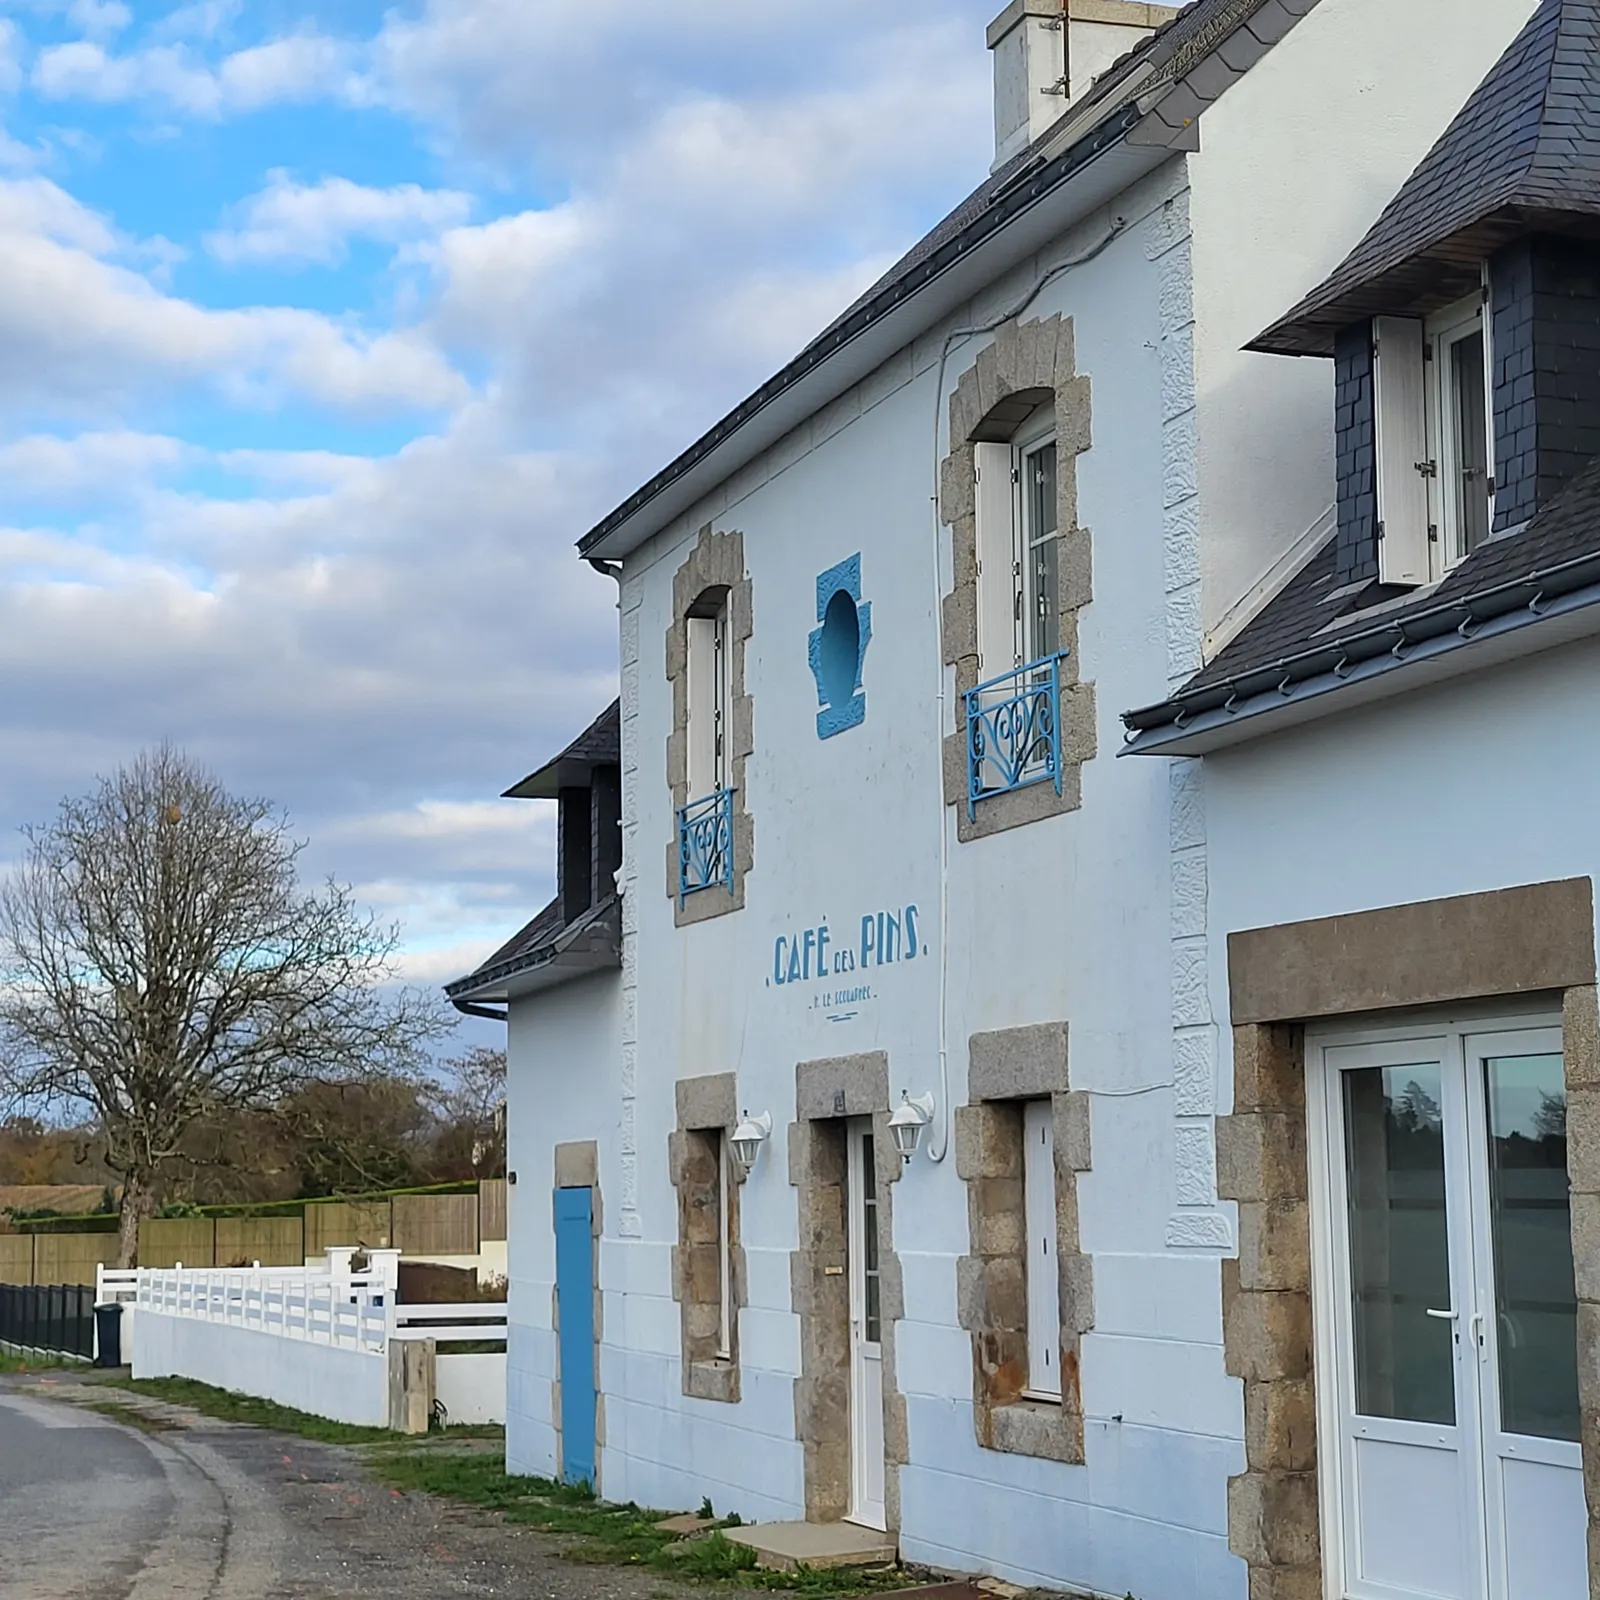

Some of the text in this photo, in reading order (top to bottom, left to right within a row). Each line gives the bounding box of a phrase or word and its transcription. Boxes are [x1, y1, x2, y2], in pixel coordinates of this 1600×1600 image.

[834, 949, 855, 974] DES
[860, 904, 919, 968] PINS
[823, 993, 831, 1007] LE
